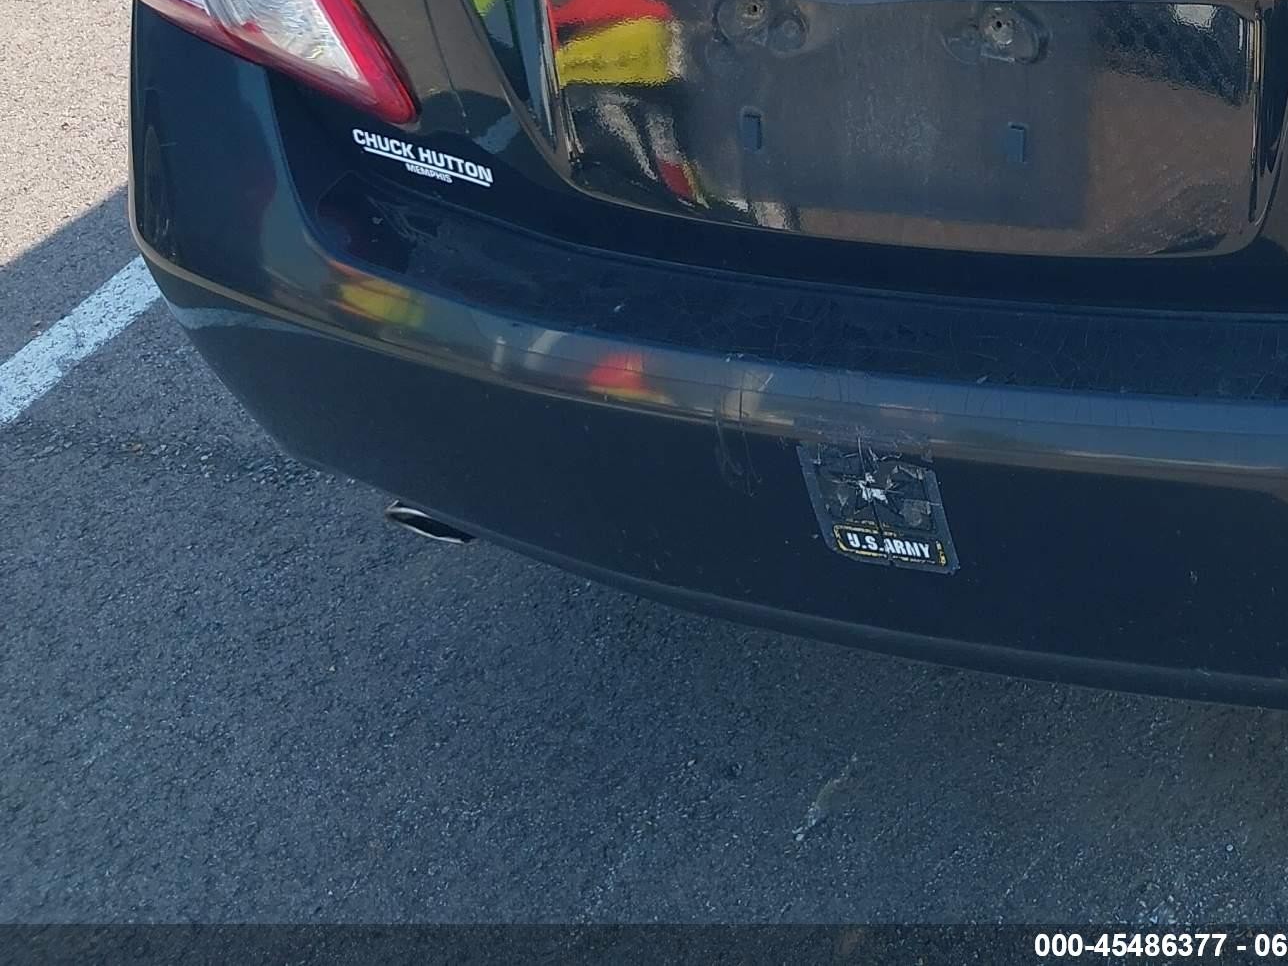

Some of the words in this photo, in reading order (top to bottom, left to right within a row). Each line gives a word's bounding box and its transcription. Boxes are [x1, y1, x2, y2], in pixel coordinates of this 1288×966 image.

[352, 128, 416, 160] CHUCK
[418, 147, 494, 183] HUTTON
[405, 163, 453, 184] MEMPHIS
